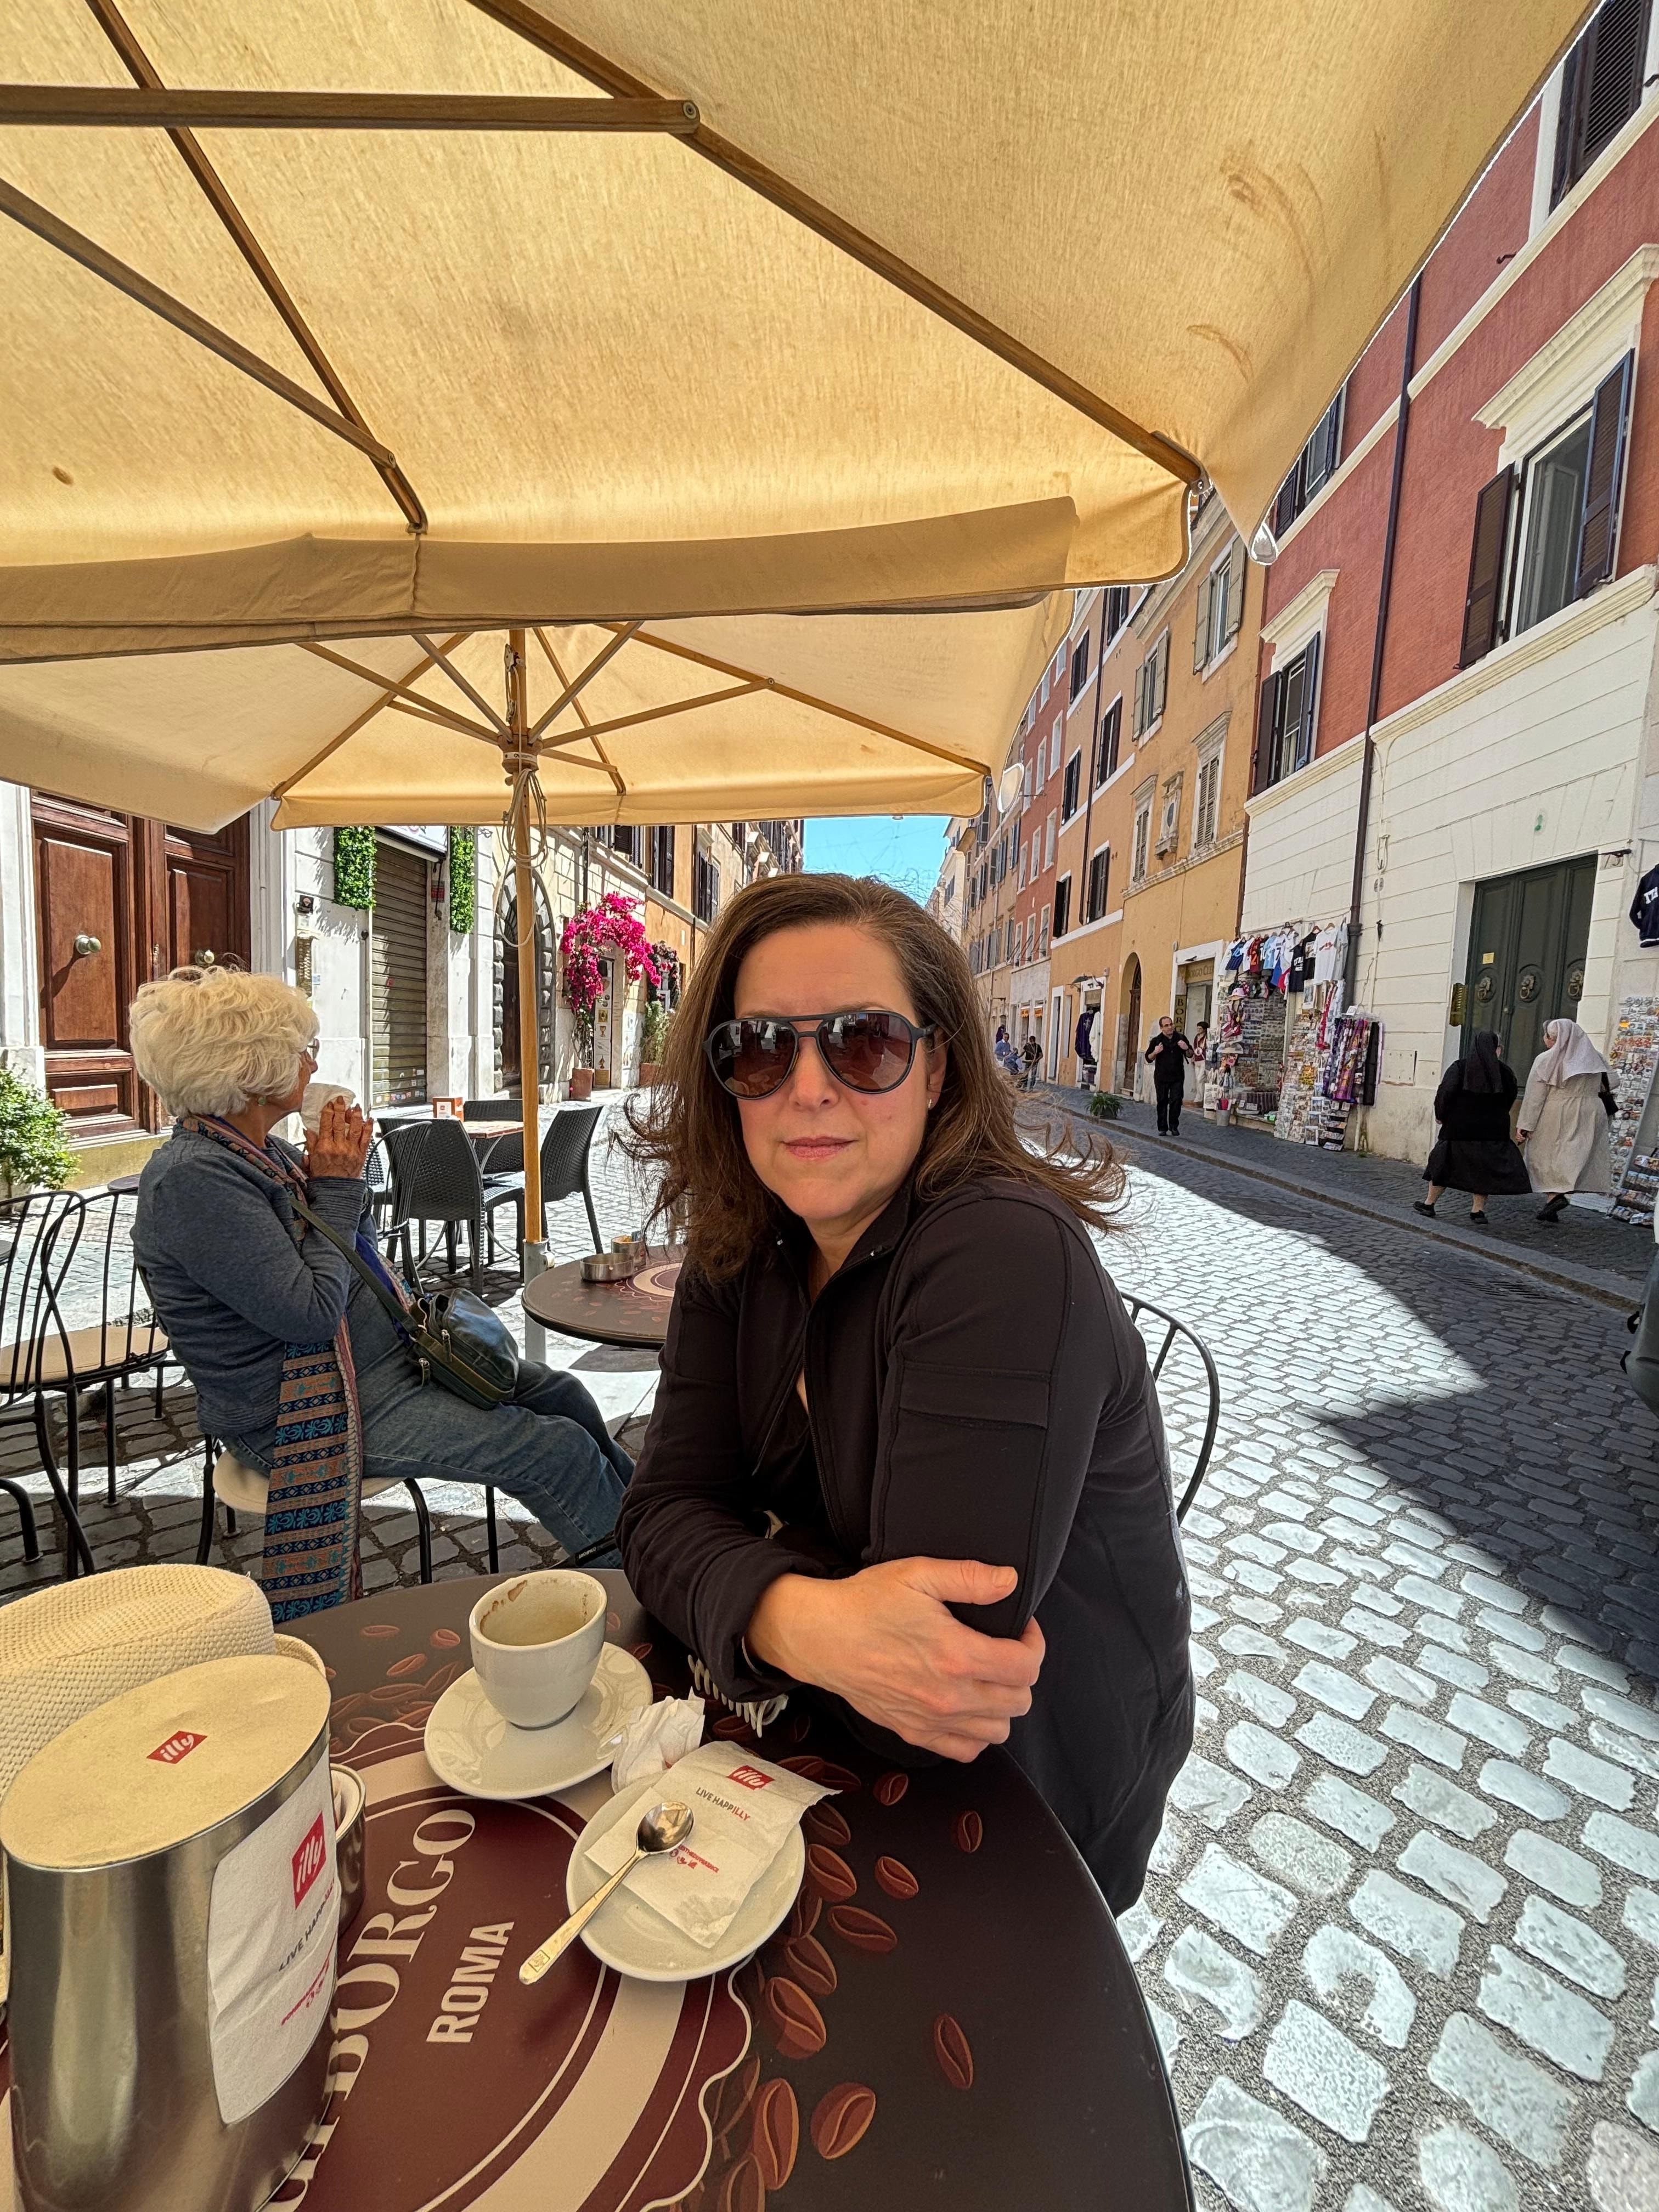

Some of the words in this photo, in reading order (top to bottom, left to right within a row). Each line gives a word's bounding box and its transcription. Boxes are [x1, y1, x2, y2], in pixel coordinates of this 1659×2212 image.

[160, 1734, 194, 1760] illy
[696, 1787, 713, 1801] LIVE
[712, 1796, 751, 1821] HAPPILLY
[296, 1836, 323, 1892] illy
[279, 1938, 304, 1972] LIVE
[426, 1921, 515, 2043] ROMA
